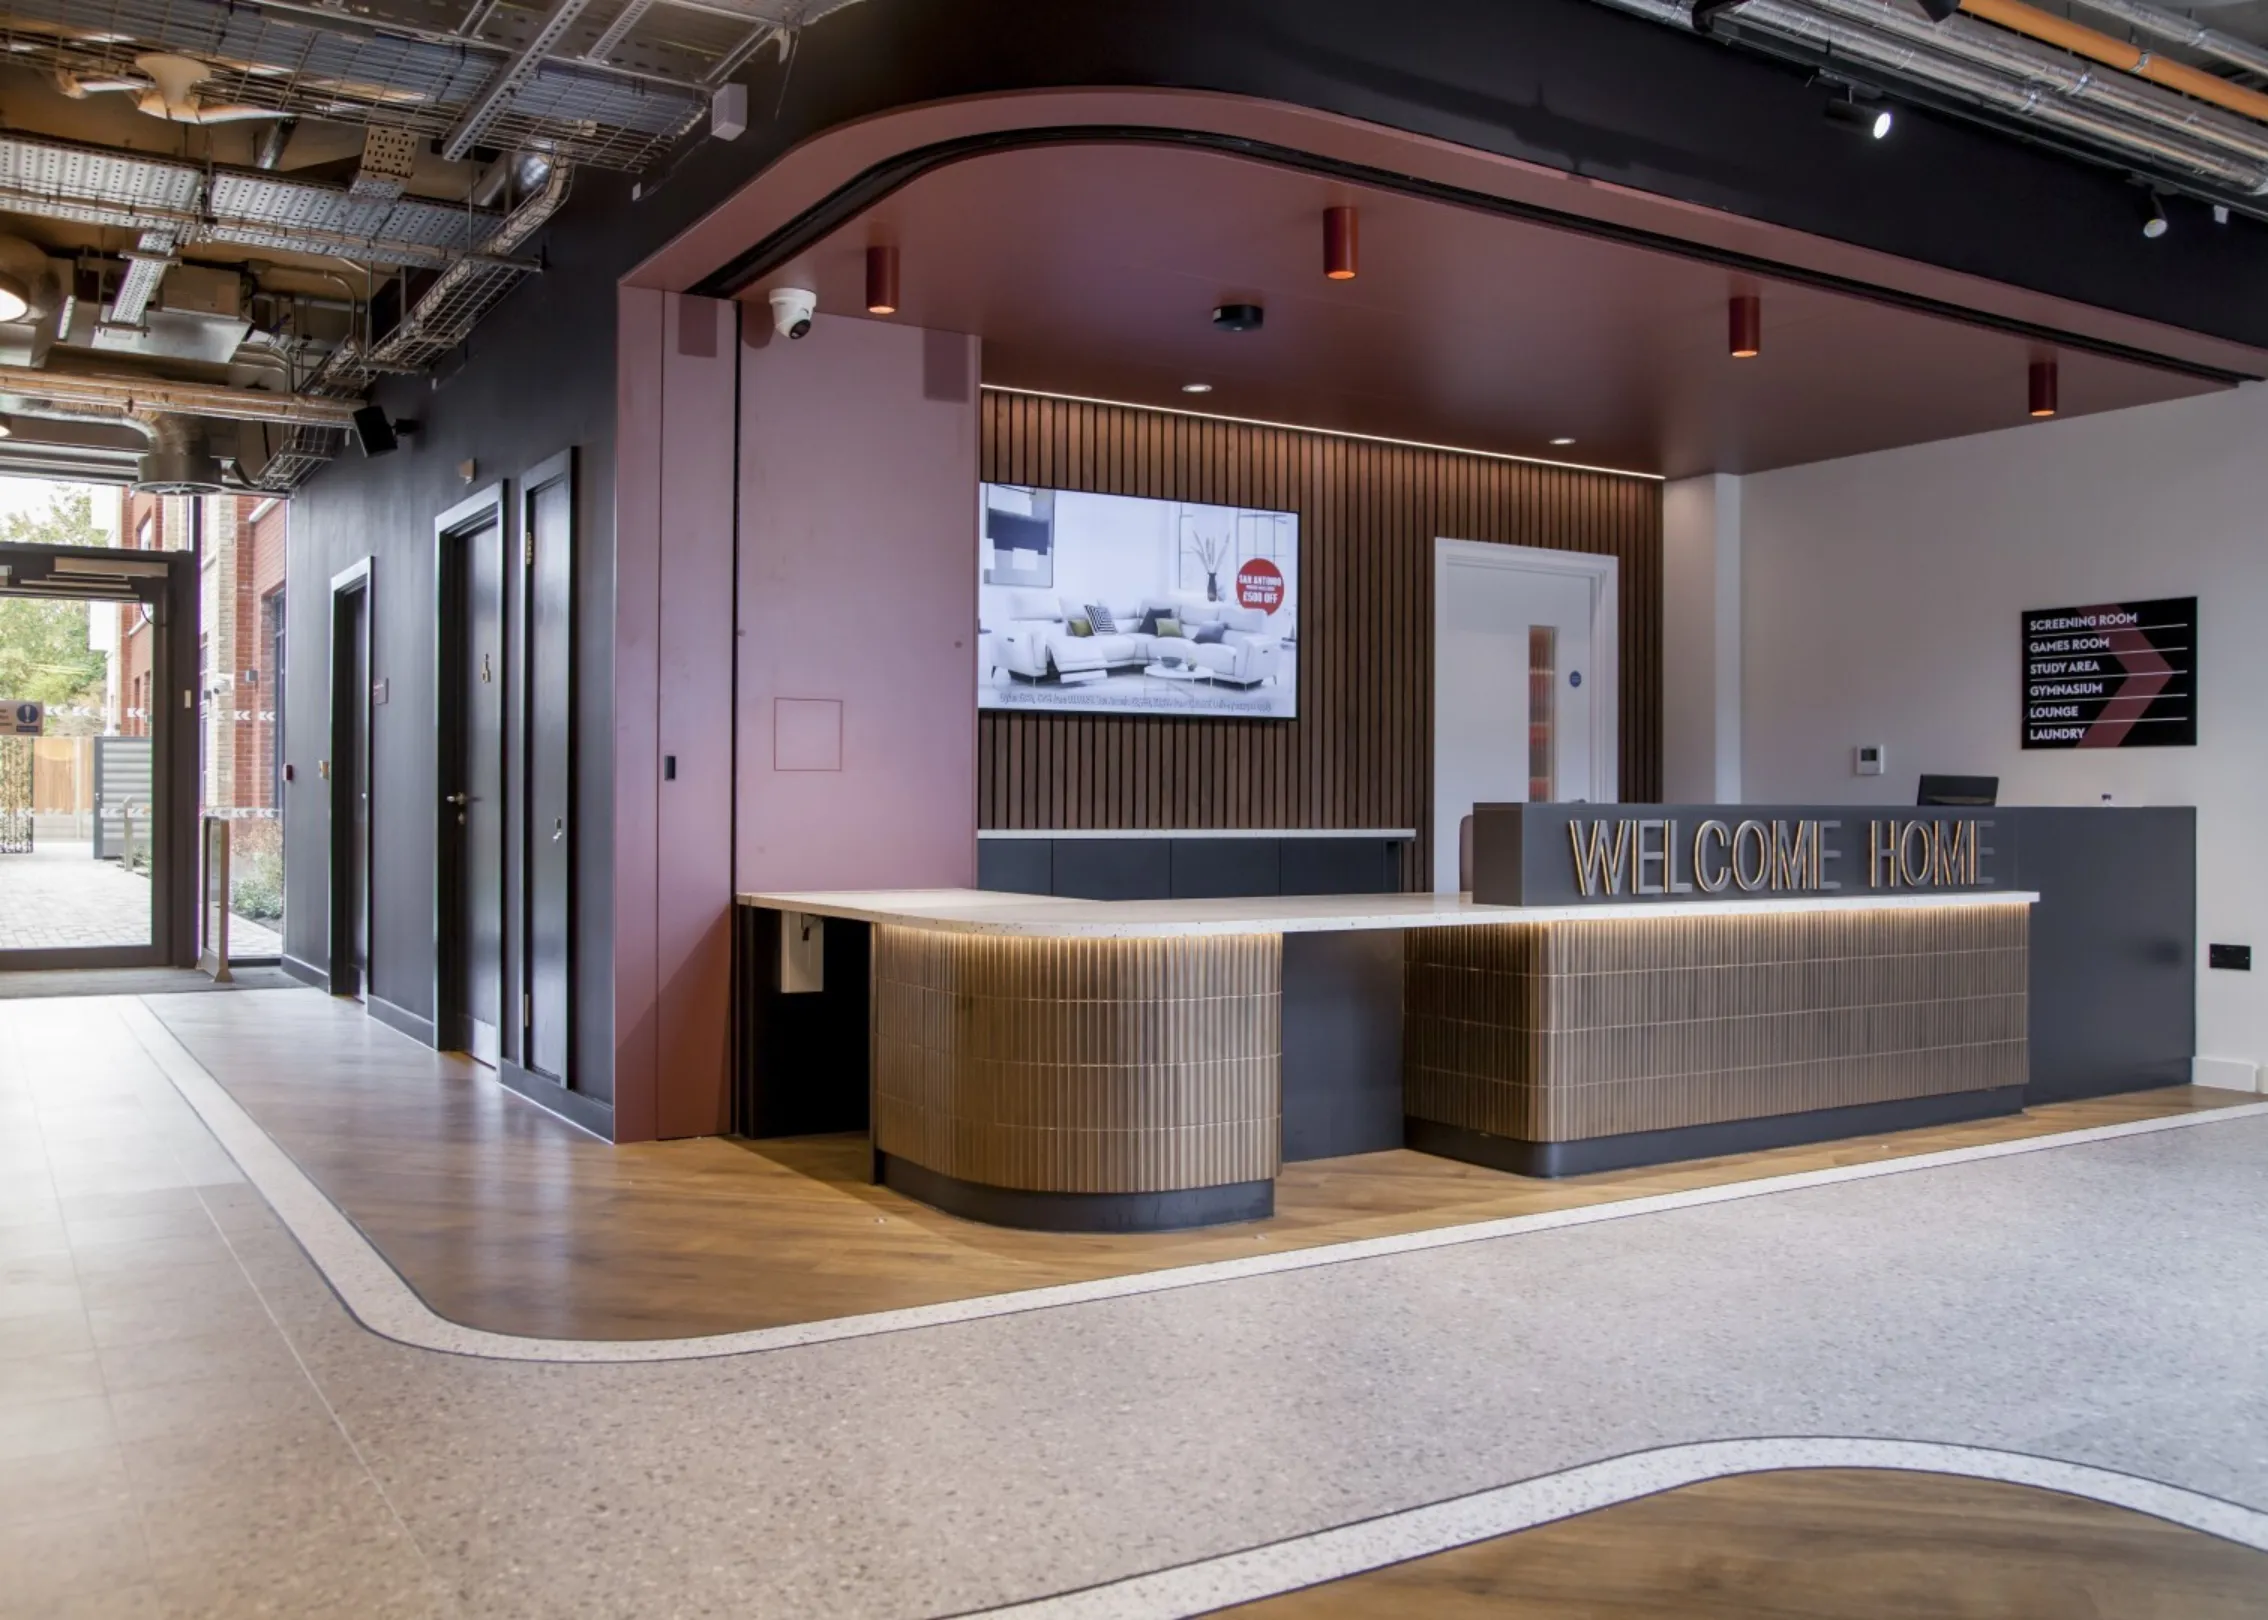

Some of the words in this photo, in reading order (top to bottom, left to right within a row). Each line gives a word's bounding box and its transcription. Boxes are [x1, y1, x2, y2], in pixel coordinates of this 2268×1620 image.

[1264, 592, 1278, 604] OFF
[2030, 615, 2097, 631] SCREENING
[2099, 612, 2138, 625] ROOM
[2030, 640, 2070, 653] GAMES
[2072, 637, 2110, 650] ROOM
[2030, 661, 2067, 675] STUDY
[2068, 660, 2100, 673] AREA
[2030, 682, 2103, 696] GYMNASIUM
[2030, 706, 2079, 718] LOUNGE
[2030, 728, 2086, 740] LAUNDRY
[1569, 819, 1842, 896] WELCOME
[1869, 819, 1996, 889] HOME
